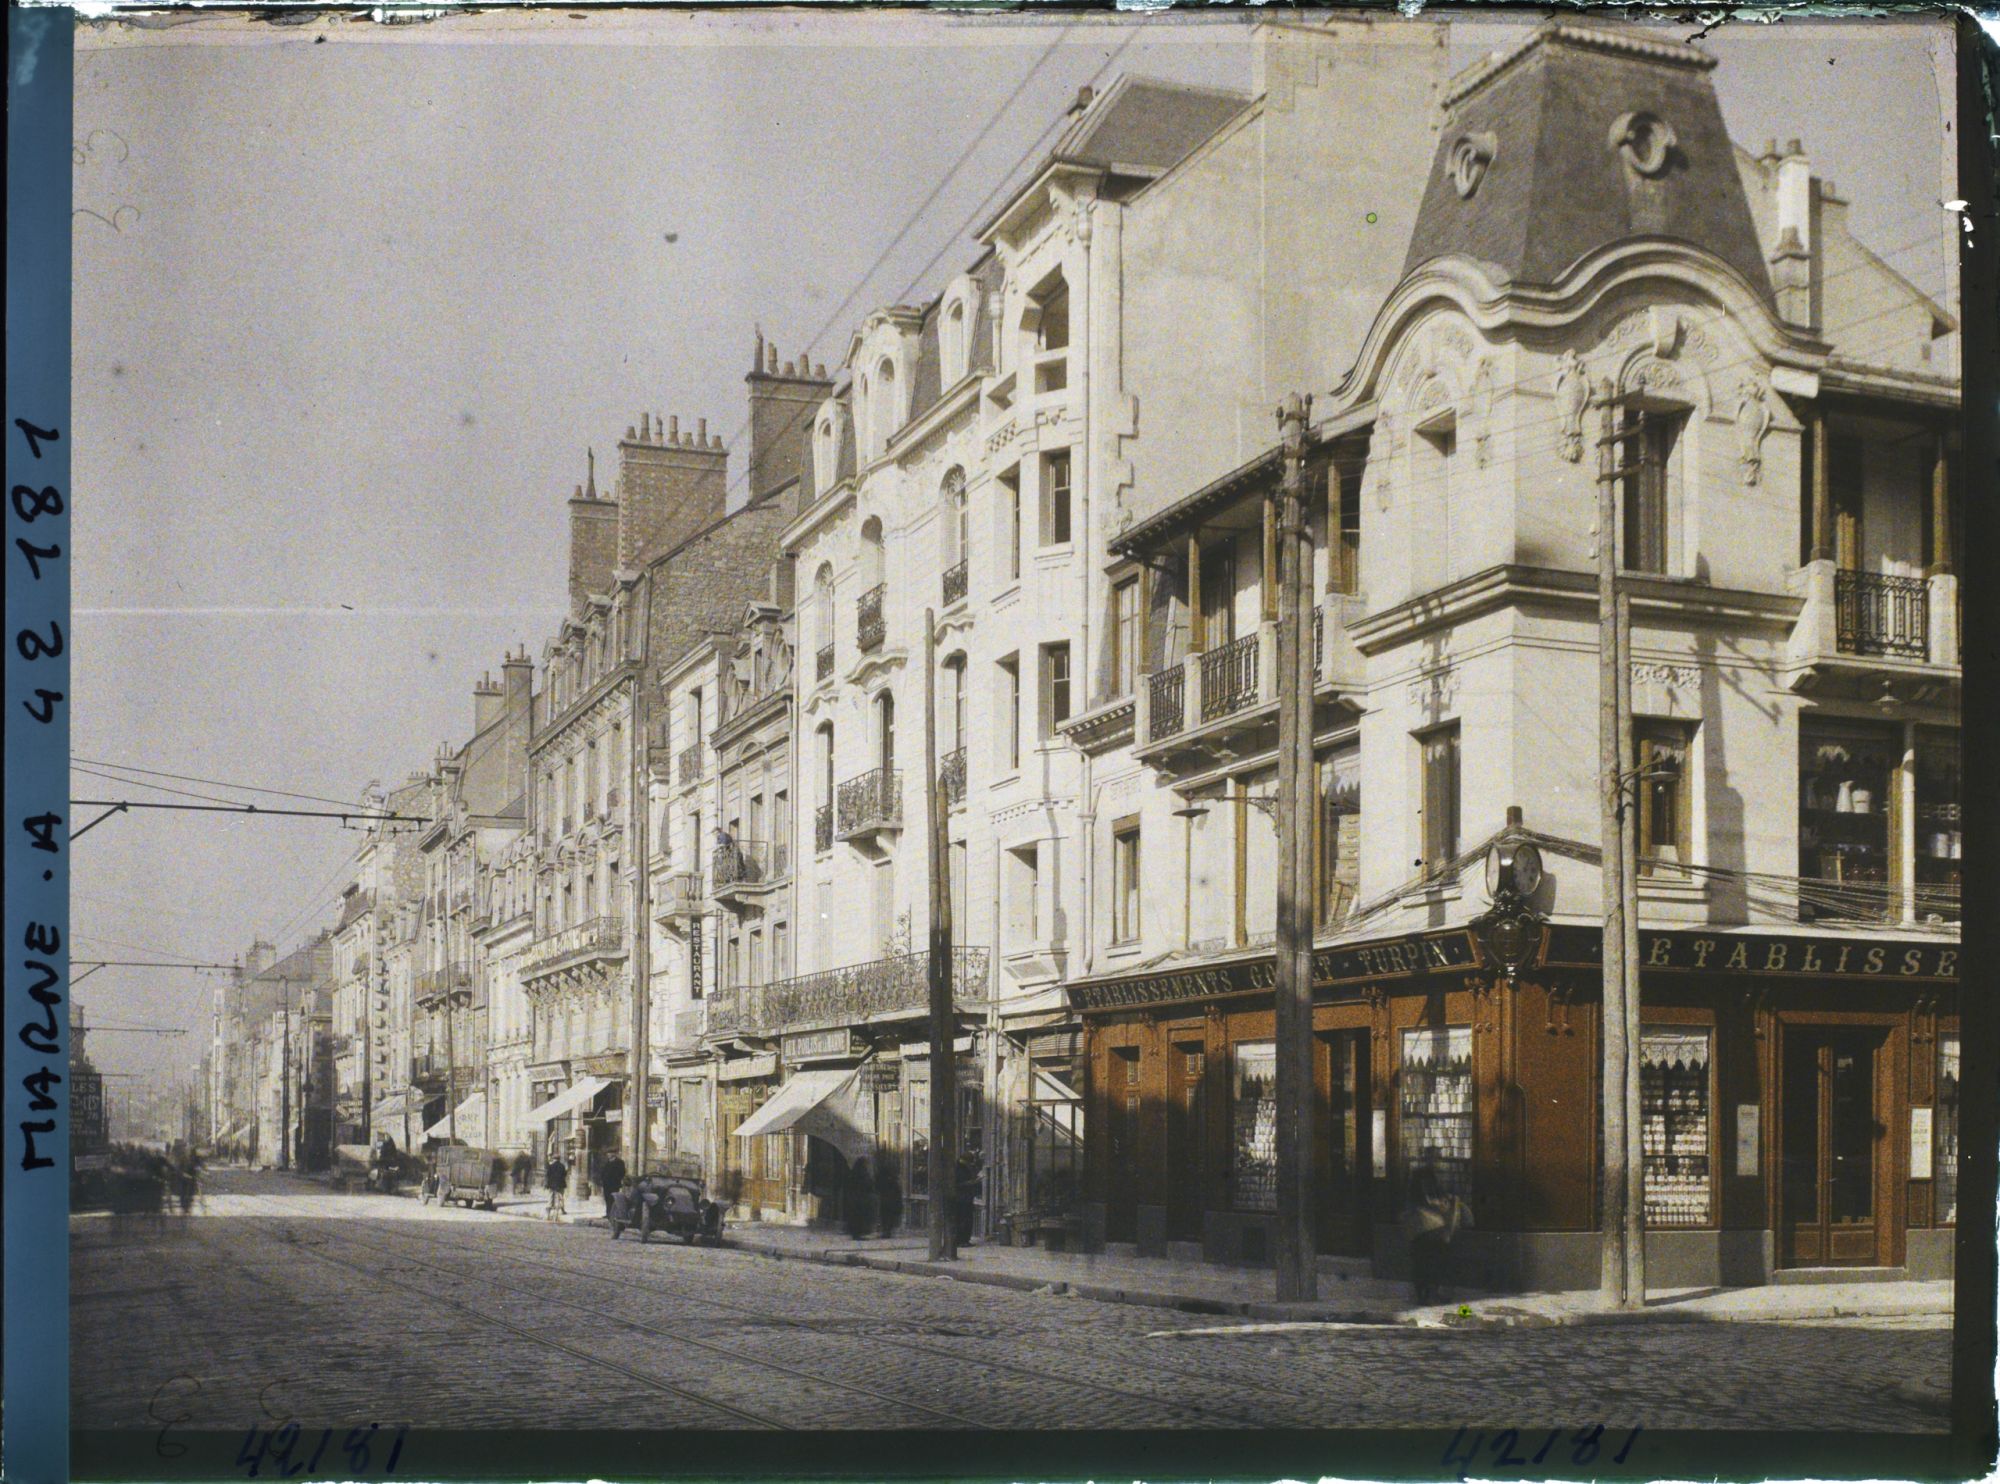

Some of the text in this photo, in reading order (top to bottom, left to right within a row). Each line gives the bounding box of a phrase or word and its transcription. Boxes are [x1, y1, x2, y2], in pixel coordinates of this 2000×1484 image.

[692, 921, 701, 994] RESTAURANT
[1082, 940, 1449, 1009] ETABLISSEMENTS GOT TURPIN
[1649, 937, 1958, 977] ETABLISSE
[19, 919, 62, 1171] MARNE
[236, 1422, 409, 1478] 42181
[1440, 1424, 1645, 1482] 42181
